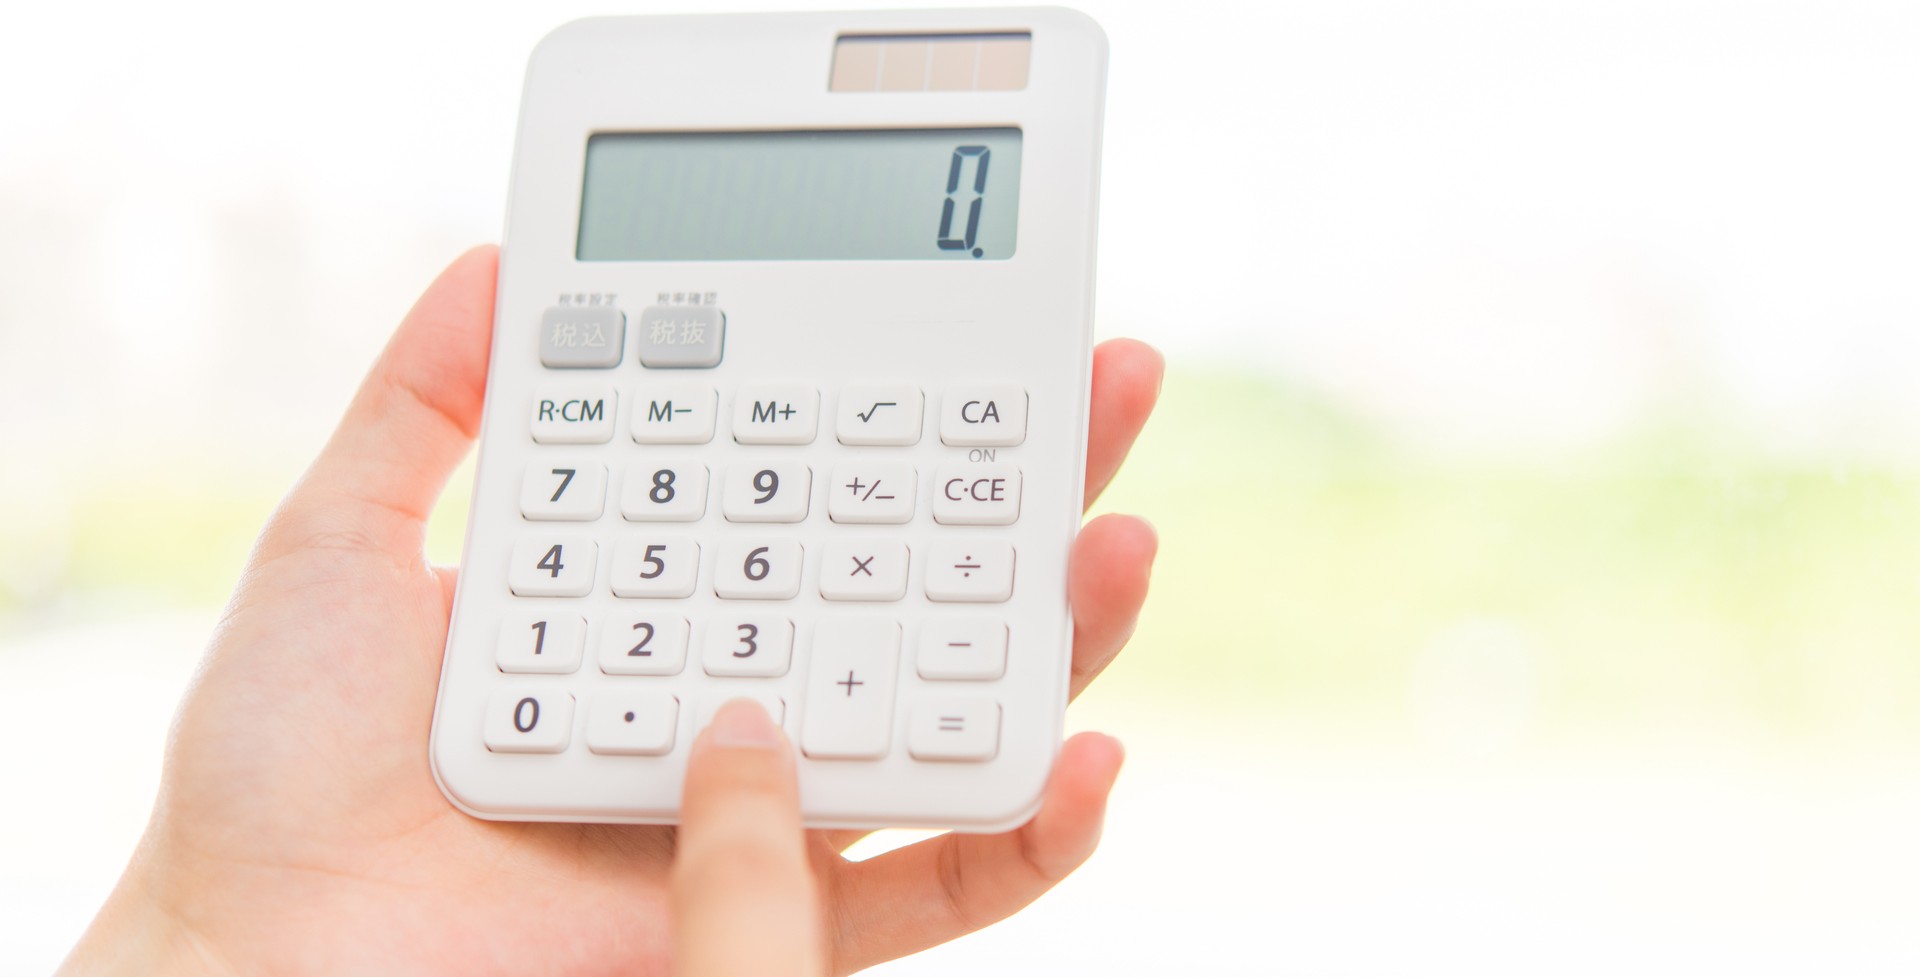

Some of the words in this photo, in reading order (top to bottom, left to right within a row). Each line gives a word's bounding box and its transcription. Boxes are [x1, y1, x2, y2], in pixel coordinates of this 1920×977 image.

[551, 322, 606, 348] 税込
[649, 319, 706, 345] 税抜
[751, 400, 797, 424] M+
[961, 400, 1001, 424] CA
[968, 448, 997, 463] ON
[549, 468, 577, 503] 7
[648, 468, 676, 504] 8
[752, 469, 780, 505] 9
[536, 544, 565, 578] 4
[639, 544, 667, 580] 5
[743, 546, 771, 582] 6
[531, 620, 547, 655] 1
[627, 622, 655, 657] 2
[732, 623, 759, 659] 3
[837, 670, 864, 697] +
[513, 696, 540, 734] 0
[938, 716, 965, 732] =
